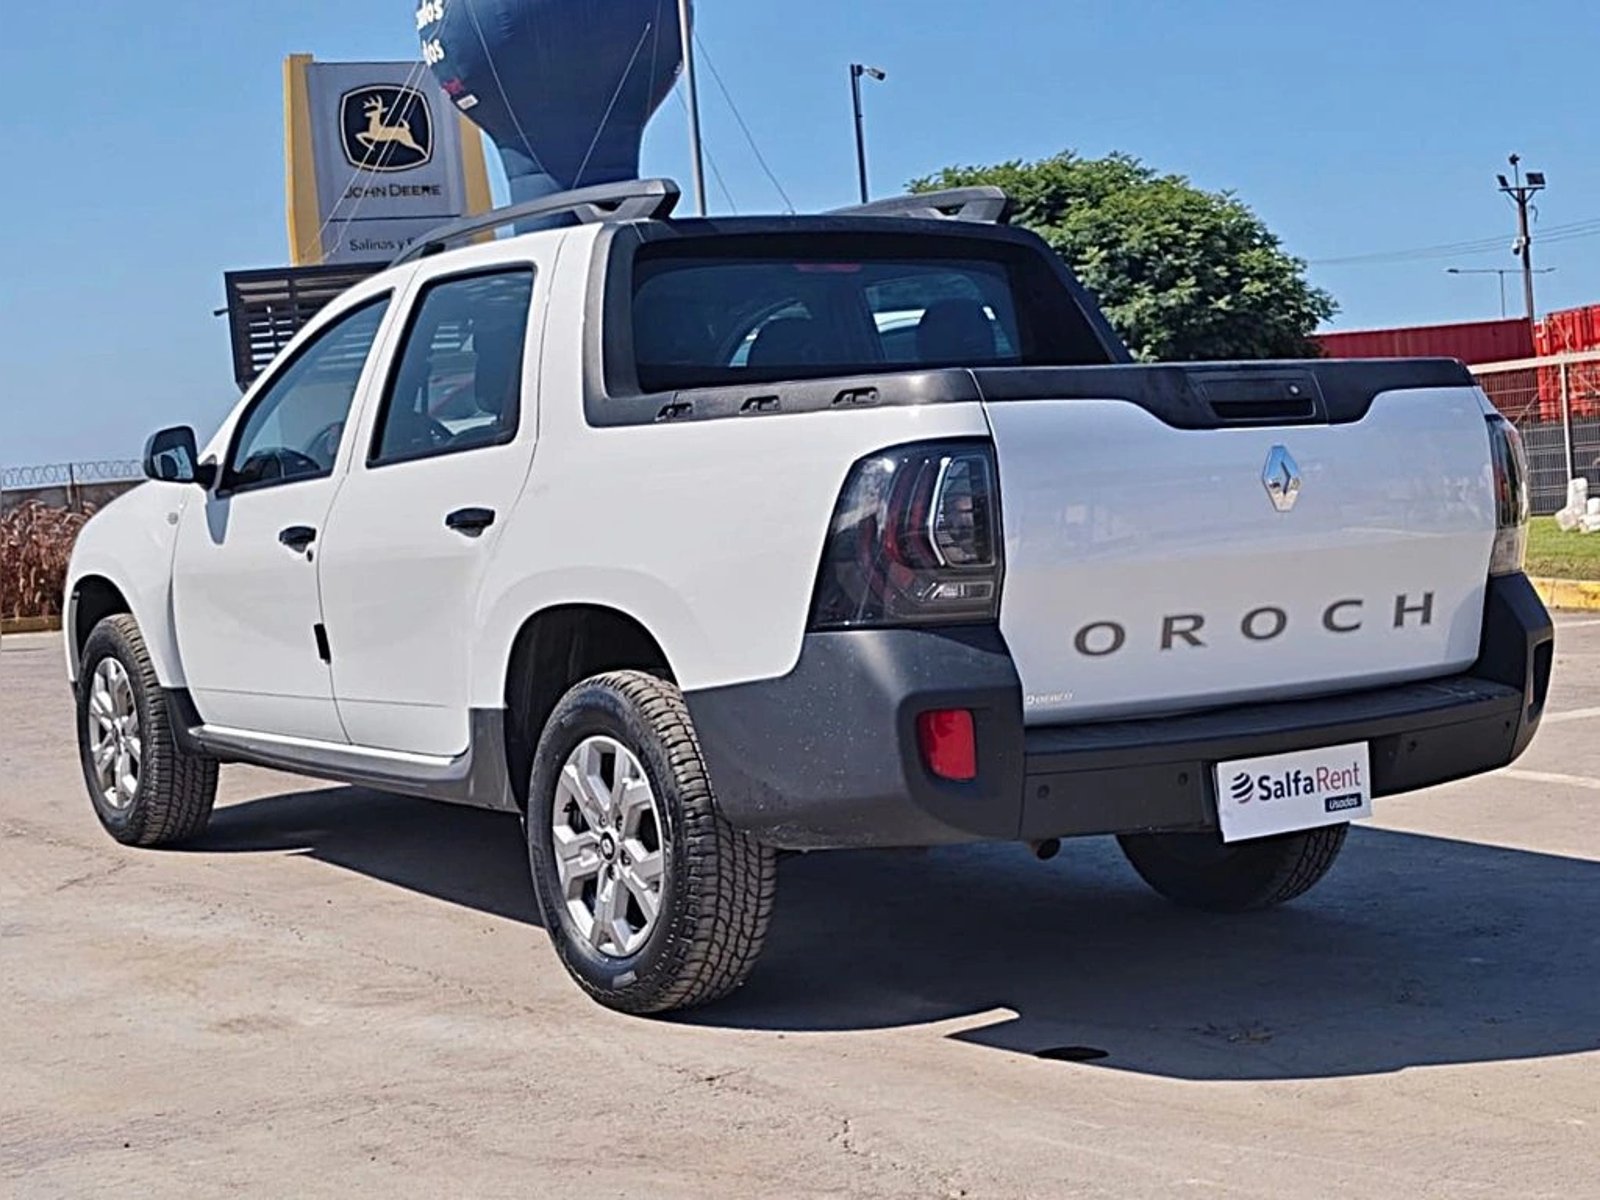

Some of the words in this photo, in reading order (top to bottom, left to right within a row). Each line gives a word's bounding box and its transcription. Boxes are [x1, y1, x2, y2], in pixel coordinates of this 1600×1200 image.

[344, 186, 387, 199] JOHN
[389, 183, 441, 197] DEERE
[1074, 591, 1435, 657] OROCH
